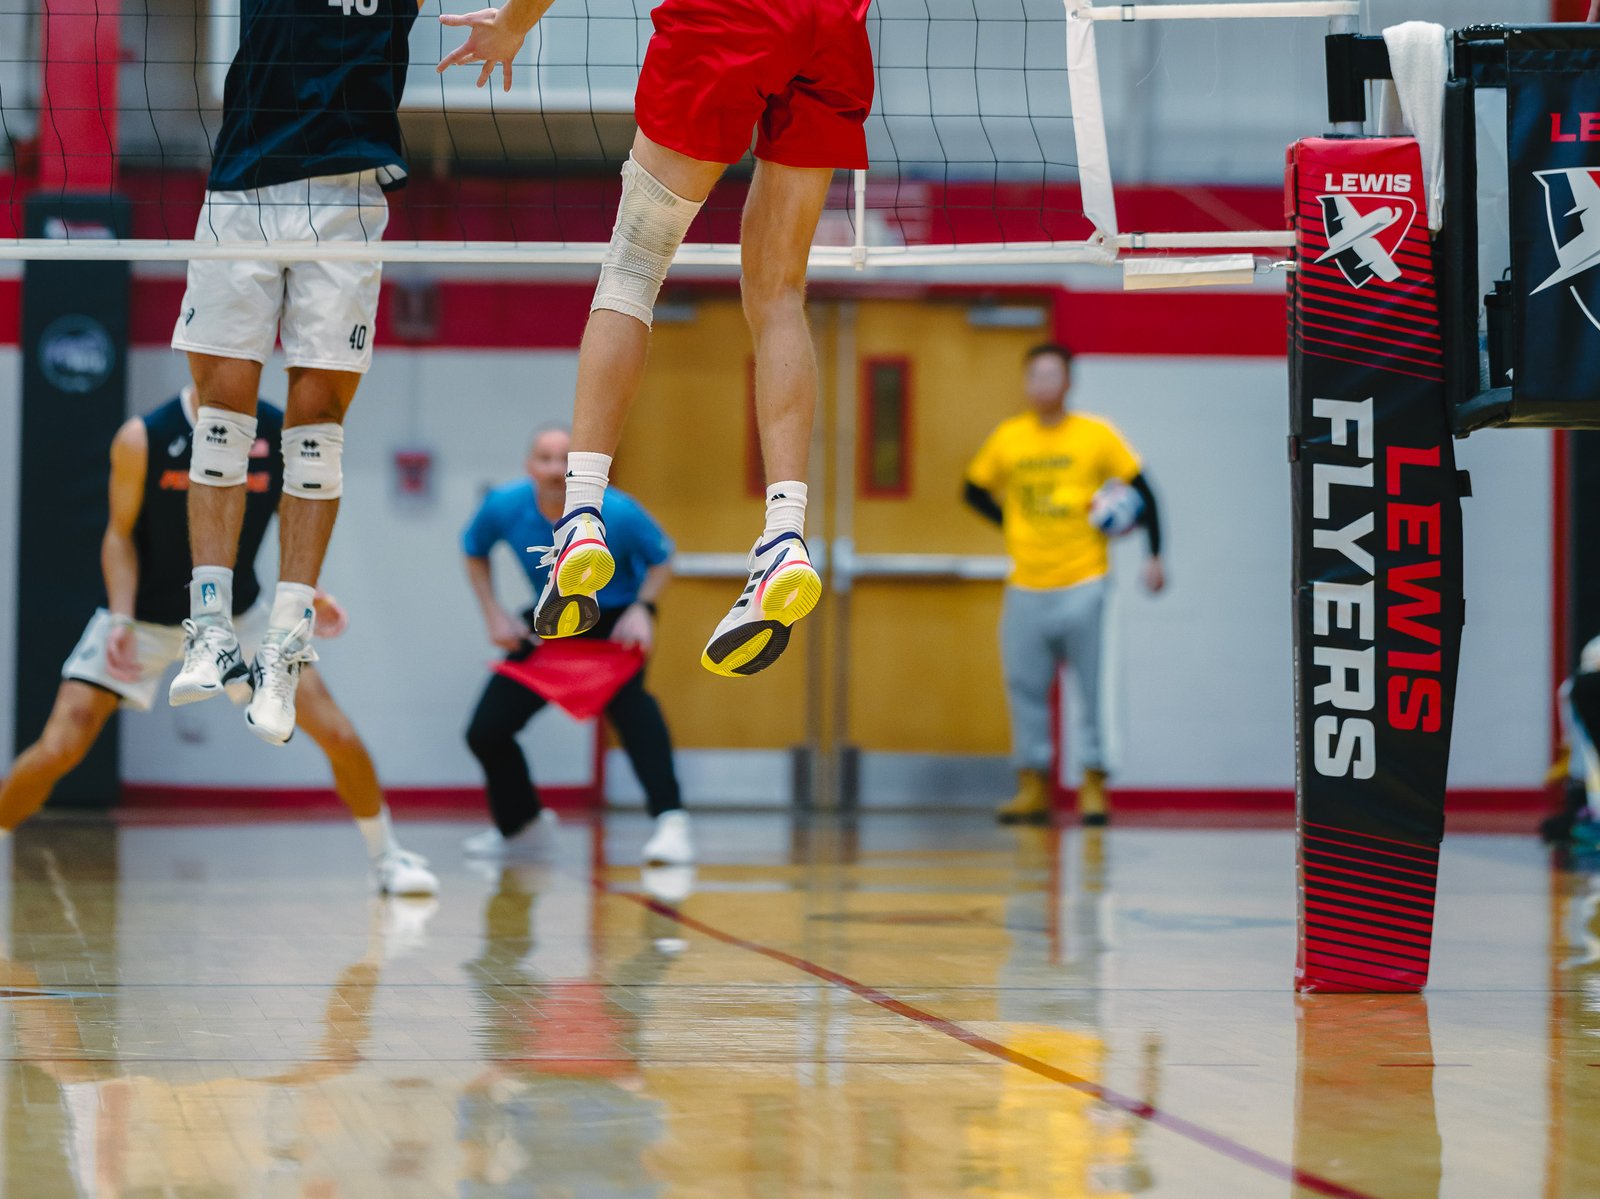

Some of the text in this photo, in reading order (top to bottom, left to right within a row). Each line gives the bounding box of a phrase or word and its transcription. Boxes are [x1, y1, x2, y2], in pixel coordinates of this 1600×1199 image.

[1325, 172, 1412, 193] LEWIS
[349, 323, 367, 350] 40
[1312, 396, 1377, 781] FLYERS
[1386, 445, 1442, 733] LEWIS
